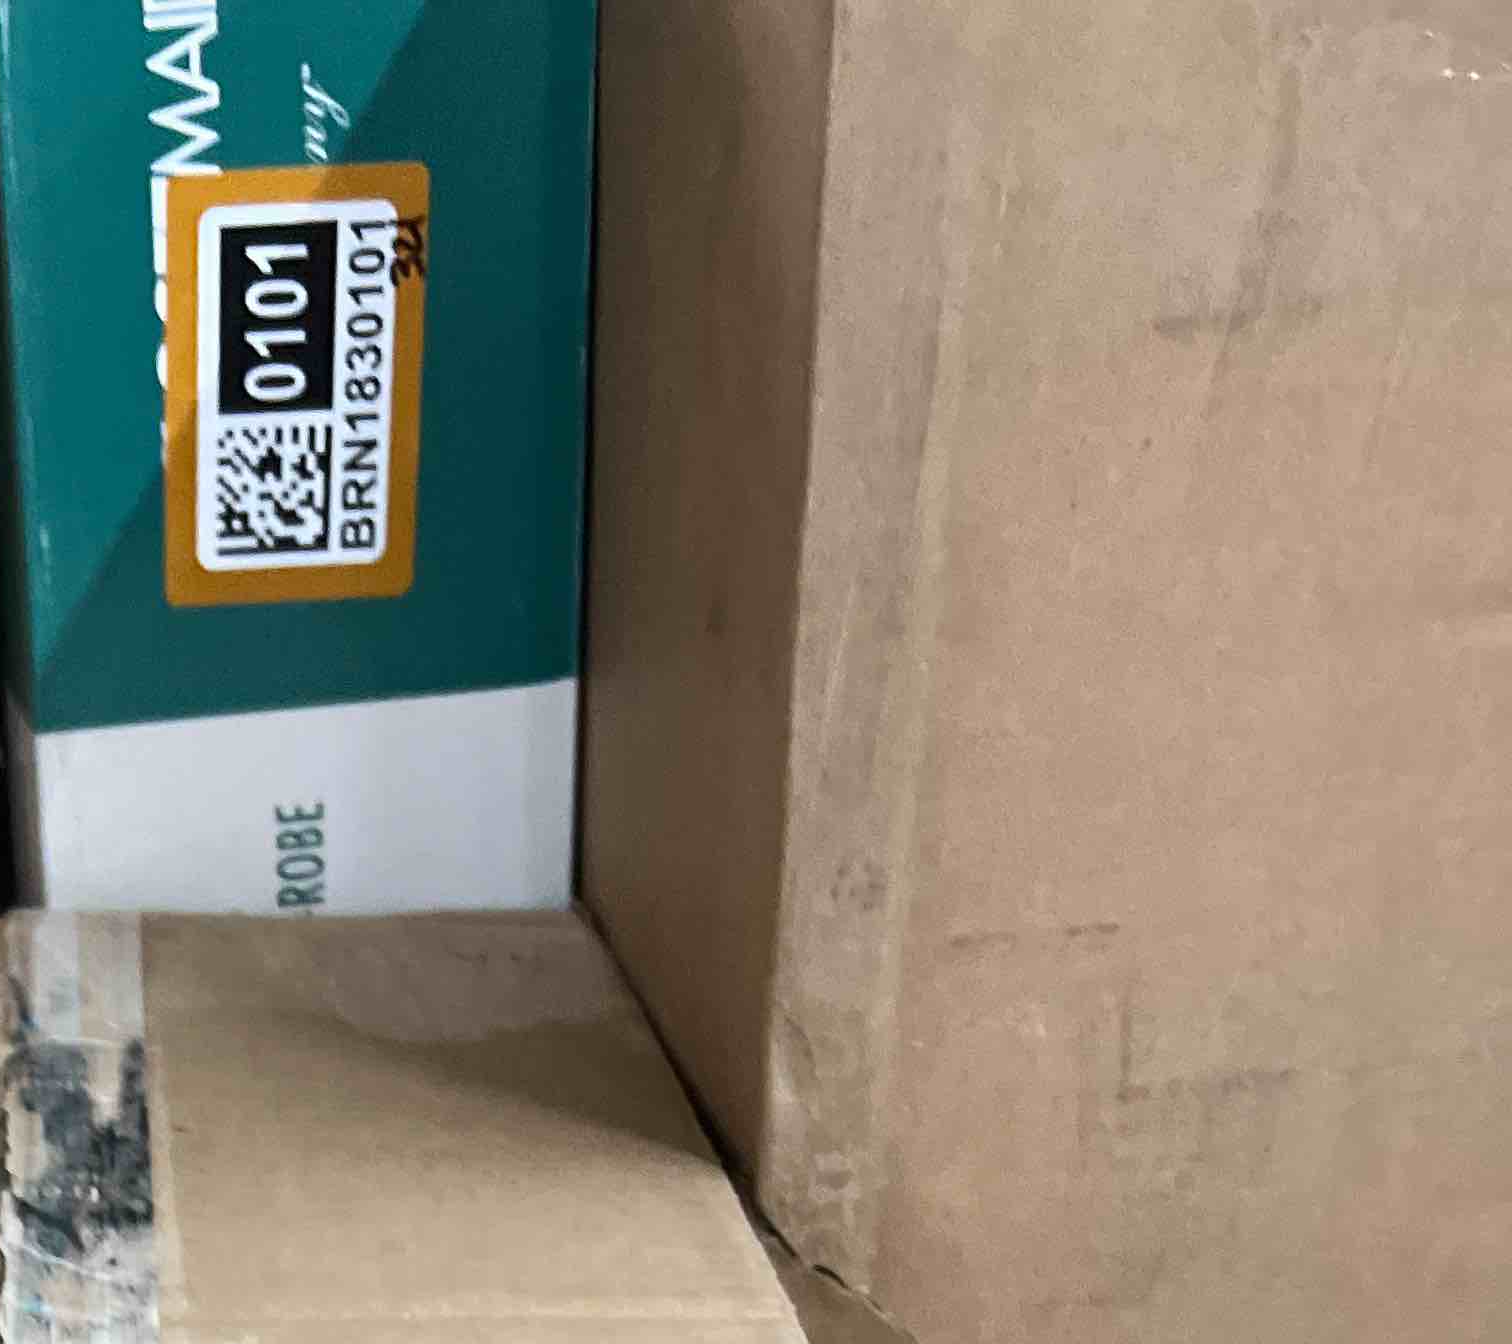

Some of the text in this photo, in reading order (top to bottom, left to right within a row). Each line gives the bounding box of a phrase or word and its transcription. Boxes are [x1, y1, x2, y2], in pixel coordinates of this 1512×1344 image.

[245, 240, 311, 404] 0101
[338, 217, 391, 551] BRN1830101
[274, 802, 326, 909] ROBE
